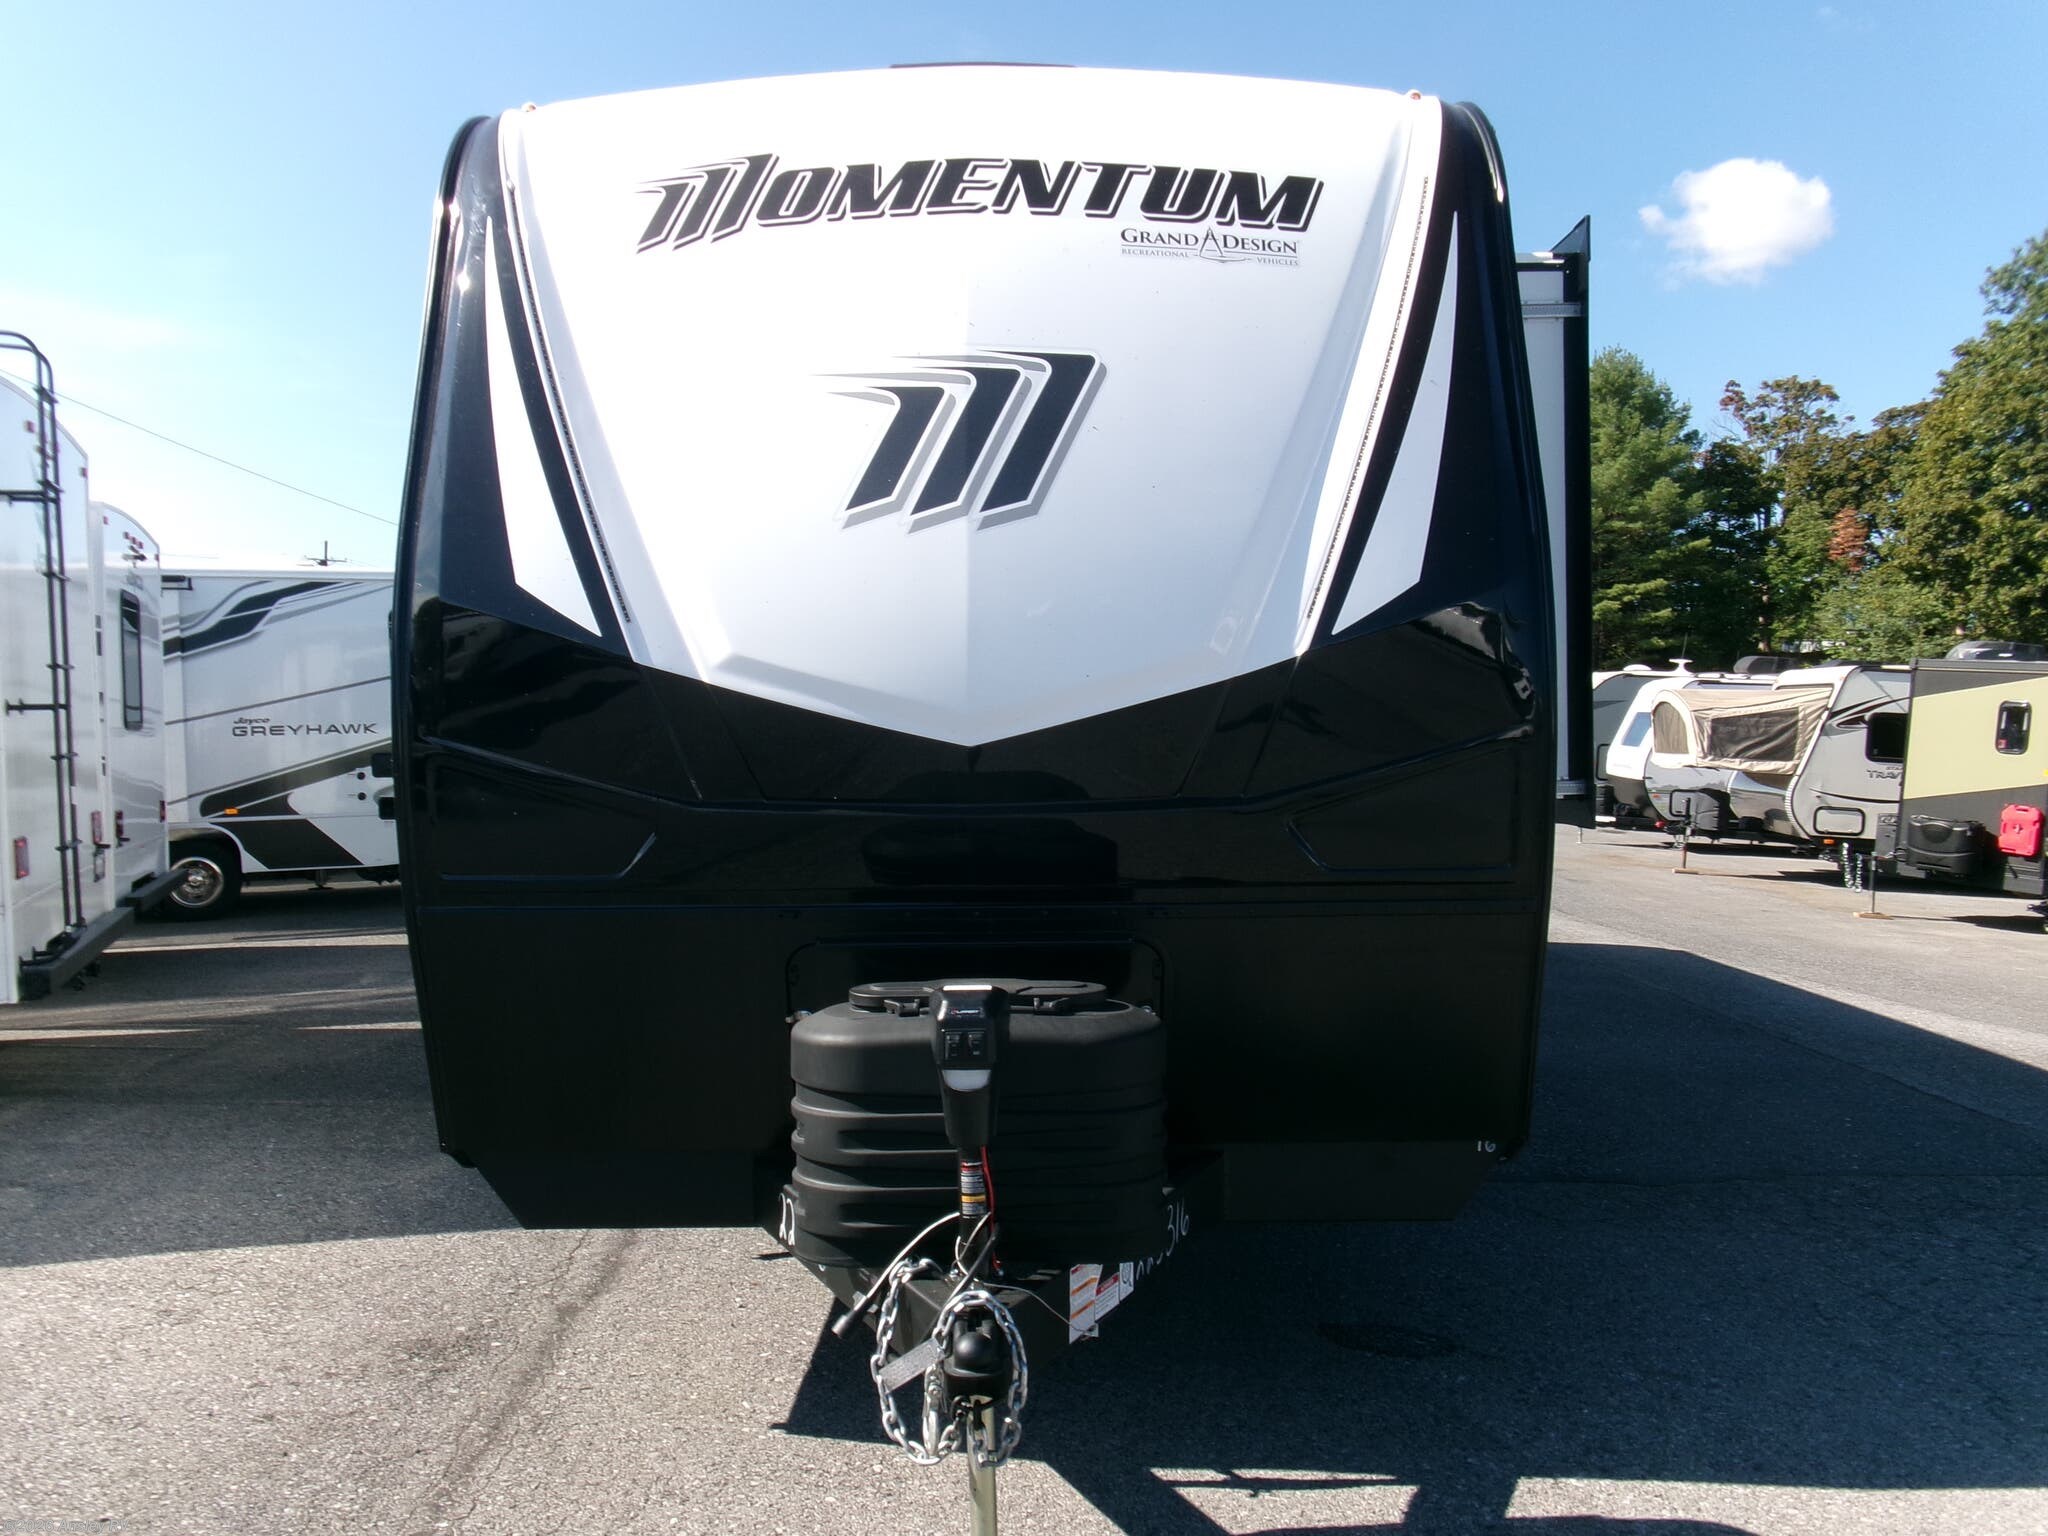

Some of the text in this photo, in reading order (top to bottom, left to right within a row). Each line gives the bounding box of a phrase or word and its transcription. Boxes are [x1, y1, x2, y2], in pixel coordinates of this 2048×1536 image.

[636, 152, 1324, 253] MOMENTUM
[1121, 228, 1297, 254] GRAND DESIGN
[1121, 248, 1298, 267] RECREATIONAL VEHICLES
[232, 723, 377, 737] GREYHAWK
